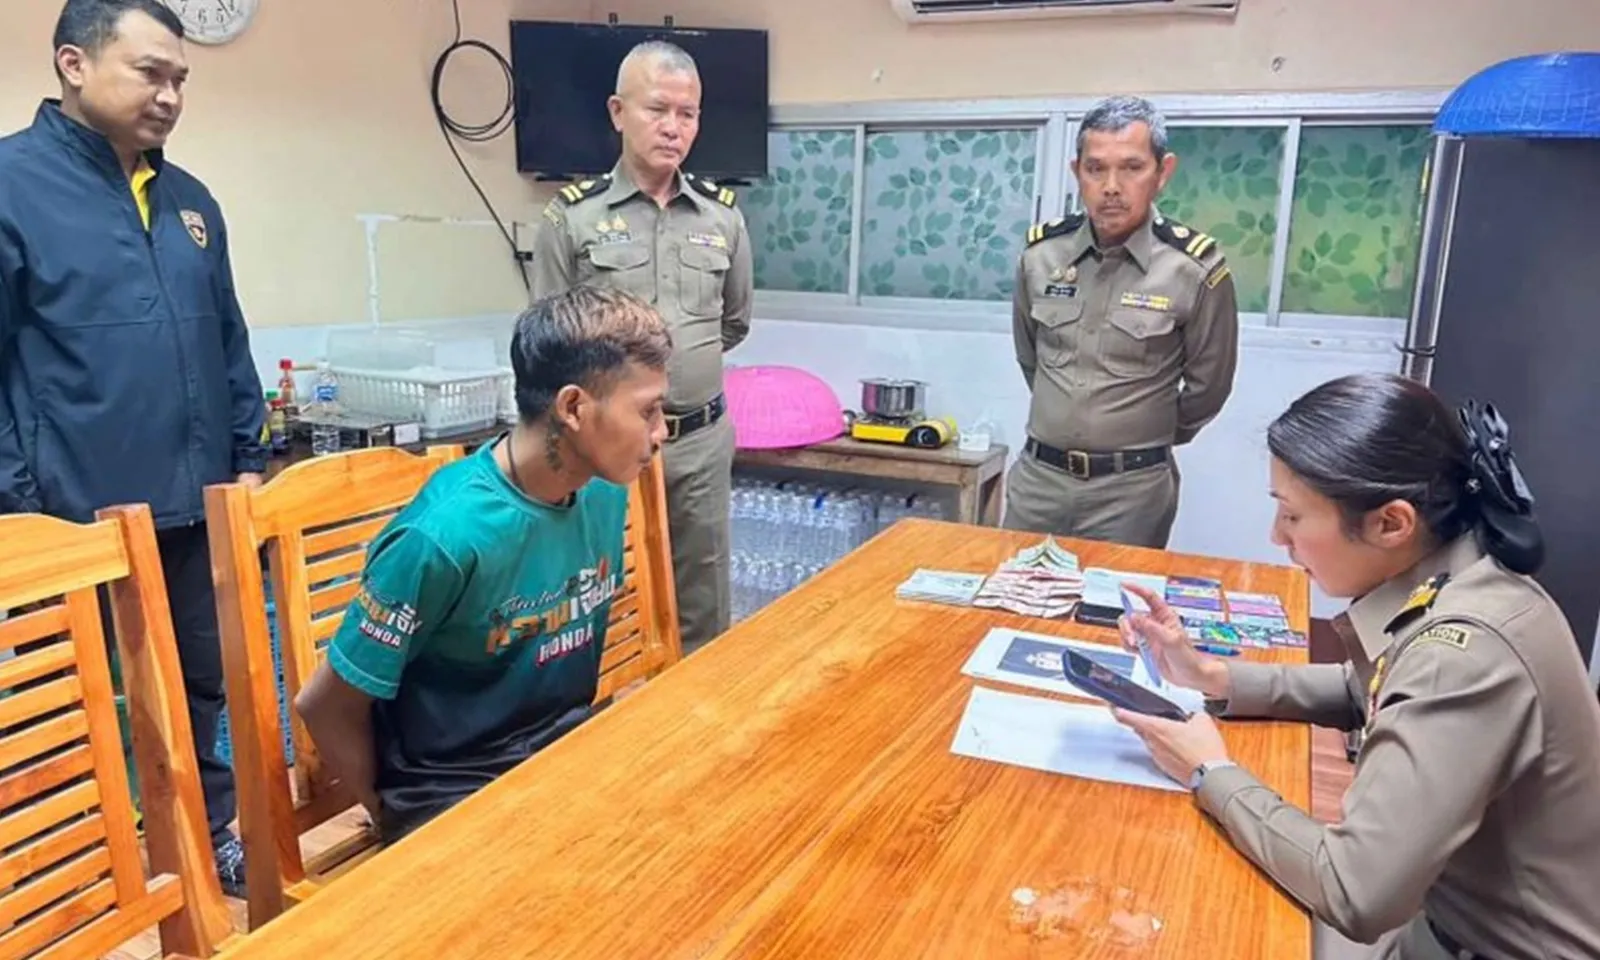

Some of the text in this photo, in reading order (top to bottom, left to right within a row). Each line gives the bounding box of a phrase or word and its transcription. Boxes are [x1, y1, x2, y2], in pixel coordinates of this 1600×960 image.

[198, 8, 207, 24] 6
[216, 8, 224, 23] 5
[360, 616, 402, 647] HONDA
[538, 621, 595, 664] HONDA
